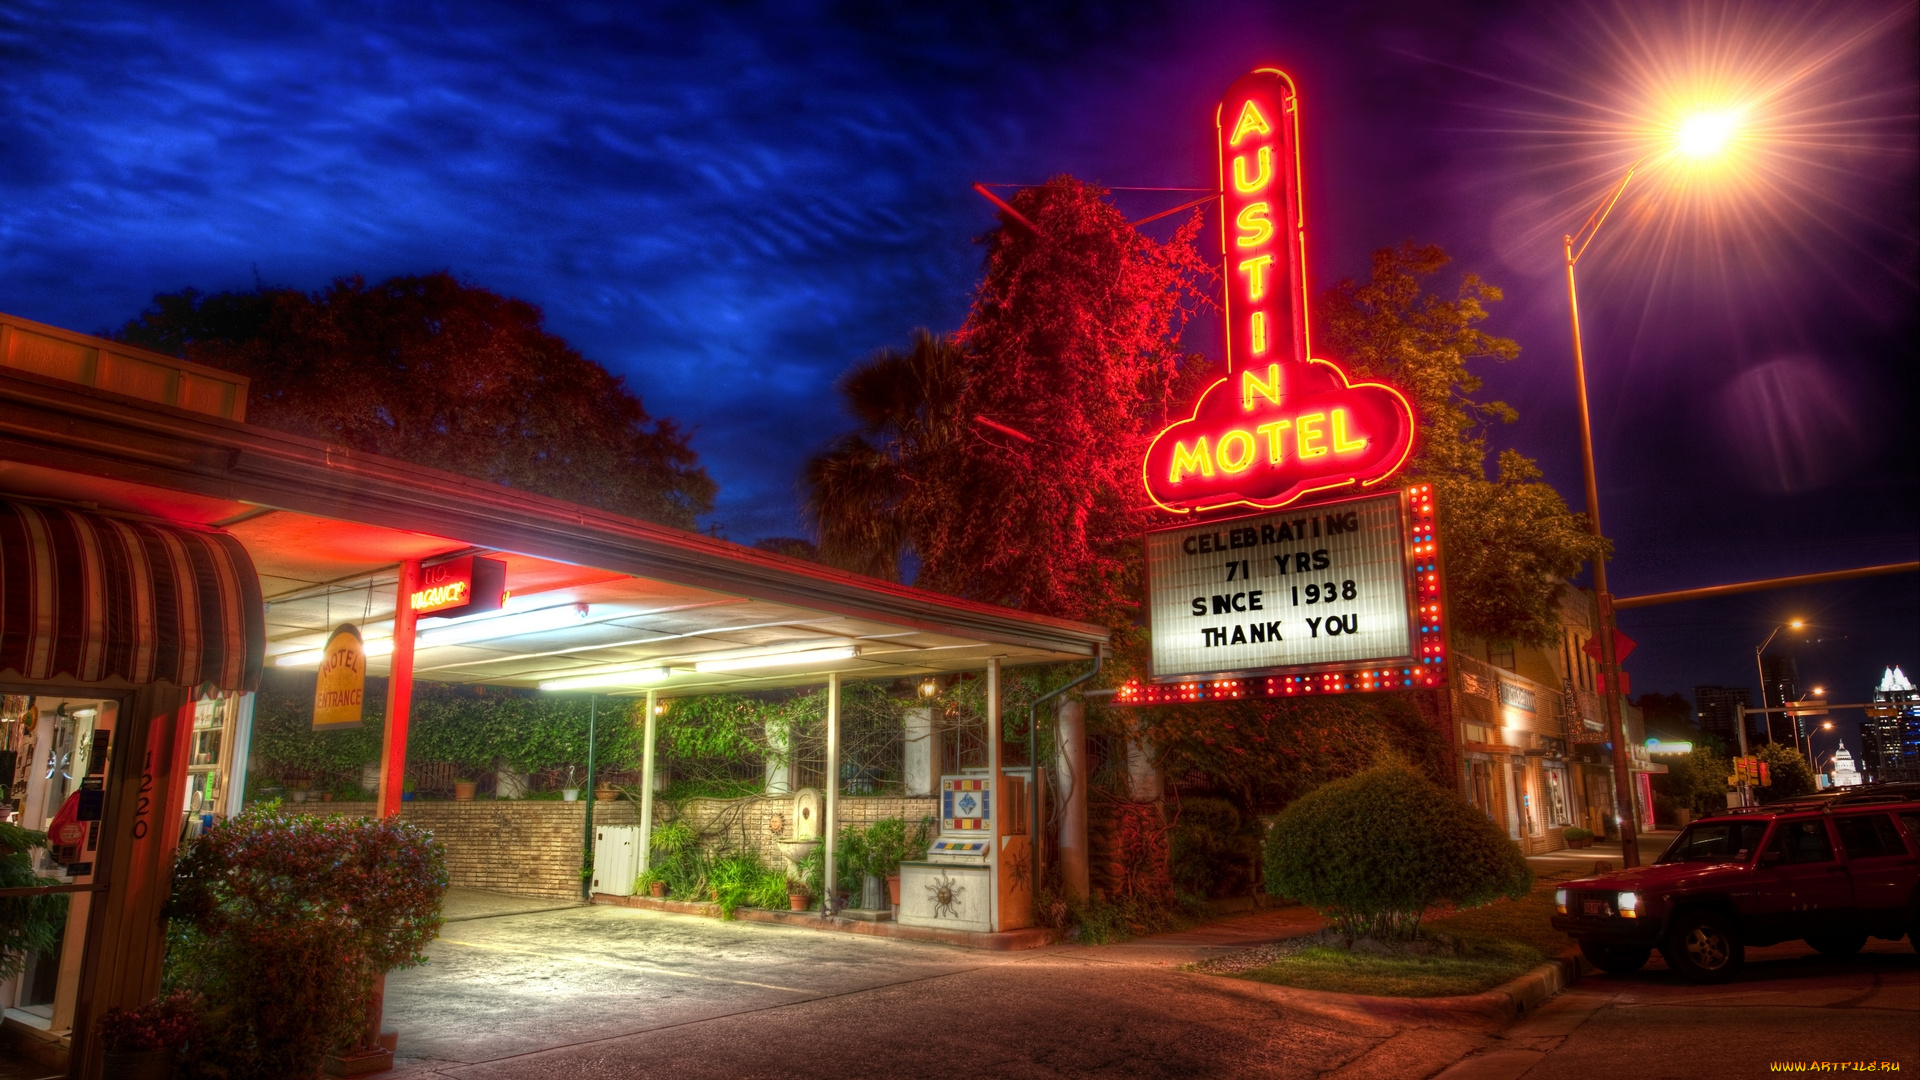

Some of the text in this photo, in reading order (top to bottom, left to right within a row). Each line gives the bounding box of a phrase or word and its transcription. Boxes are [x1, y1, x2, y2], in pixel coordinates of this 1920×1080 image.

[1230, 99, 1281, 410] AUSTIN
[1169, 409, 1367, 483] MOTEL
[1183, 514, 1359, 554] CELEBRATING
[1226, 549, 1329, 582] 71 YRS
[411, 581, 466, 609] VACANCY
[1291, 579, 1358, 607] 1938
[1201, 613, 1359, 648] THANK YOU
[322, 649, 358, 677] MOTEL
[317, 688, 362, 709] ENTRANCE
[133, 751, 153, 839] 1220
